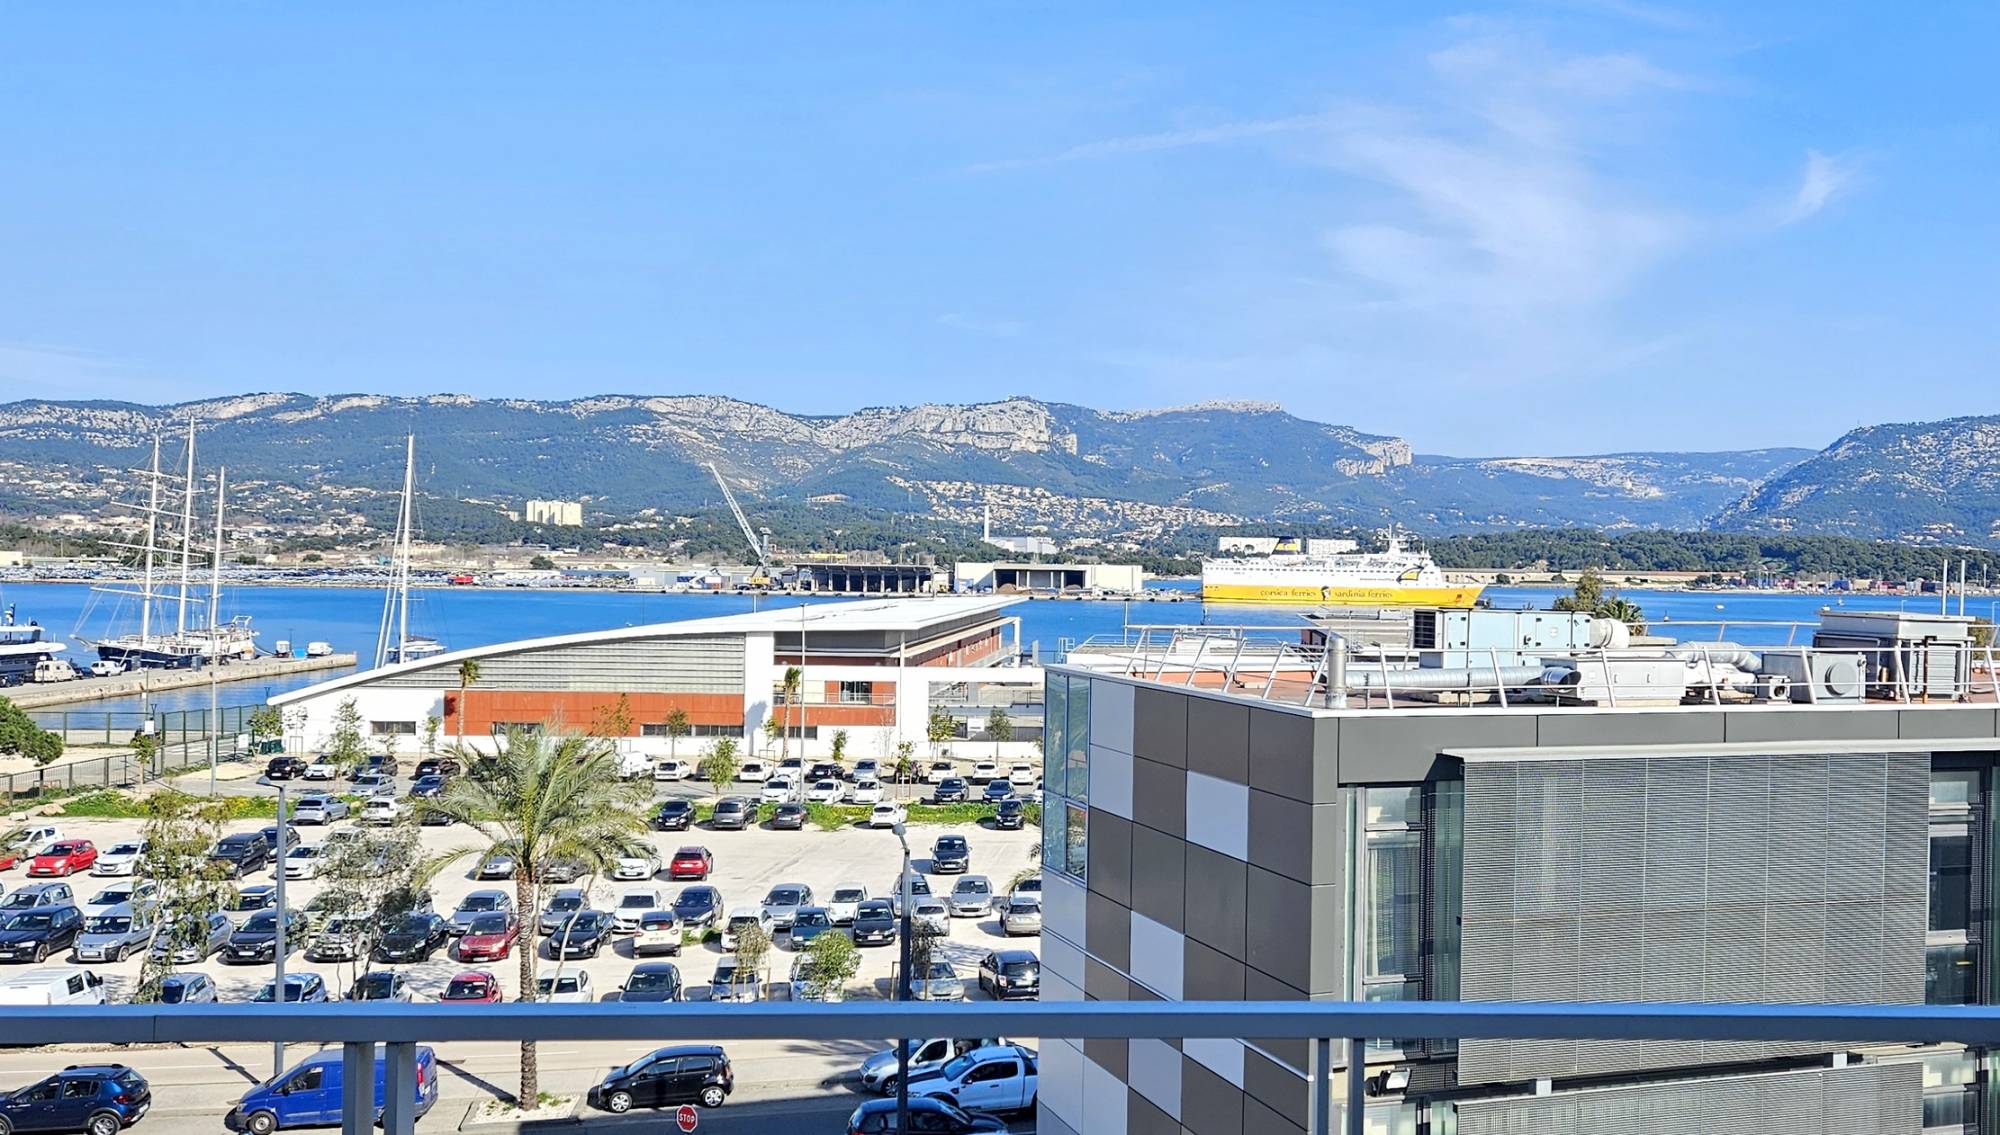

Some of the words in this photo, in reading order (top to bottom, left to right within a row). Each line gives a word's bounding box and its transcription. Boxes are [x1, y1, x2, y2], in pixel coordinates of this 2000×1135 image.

[1260, 588, 1288, 597] corsica
[1291, 588, 1316, 597] ferries
[1335, 589, 1366, 598] sardinia
[1368, 590, 1393, 599] ferries
[679, 1113, 695, 1123] STOP
